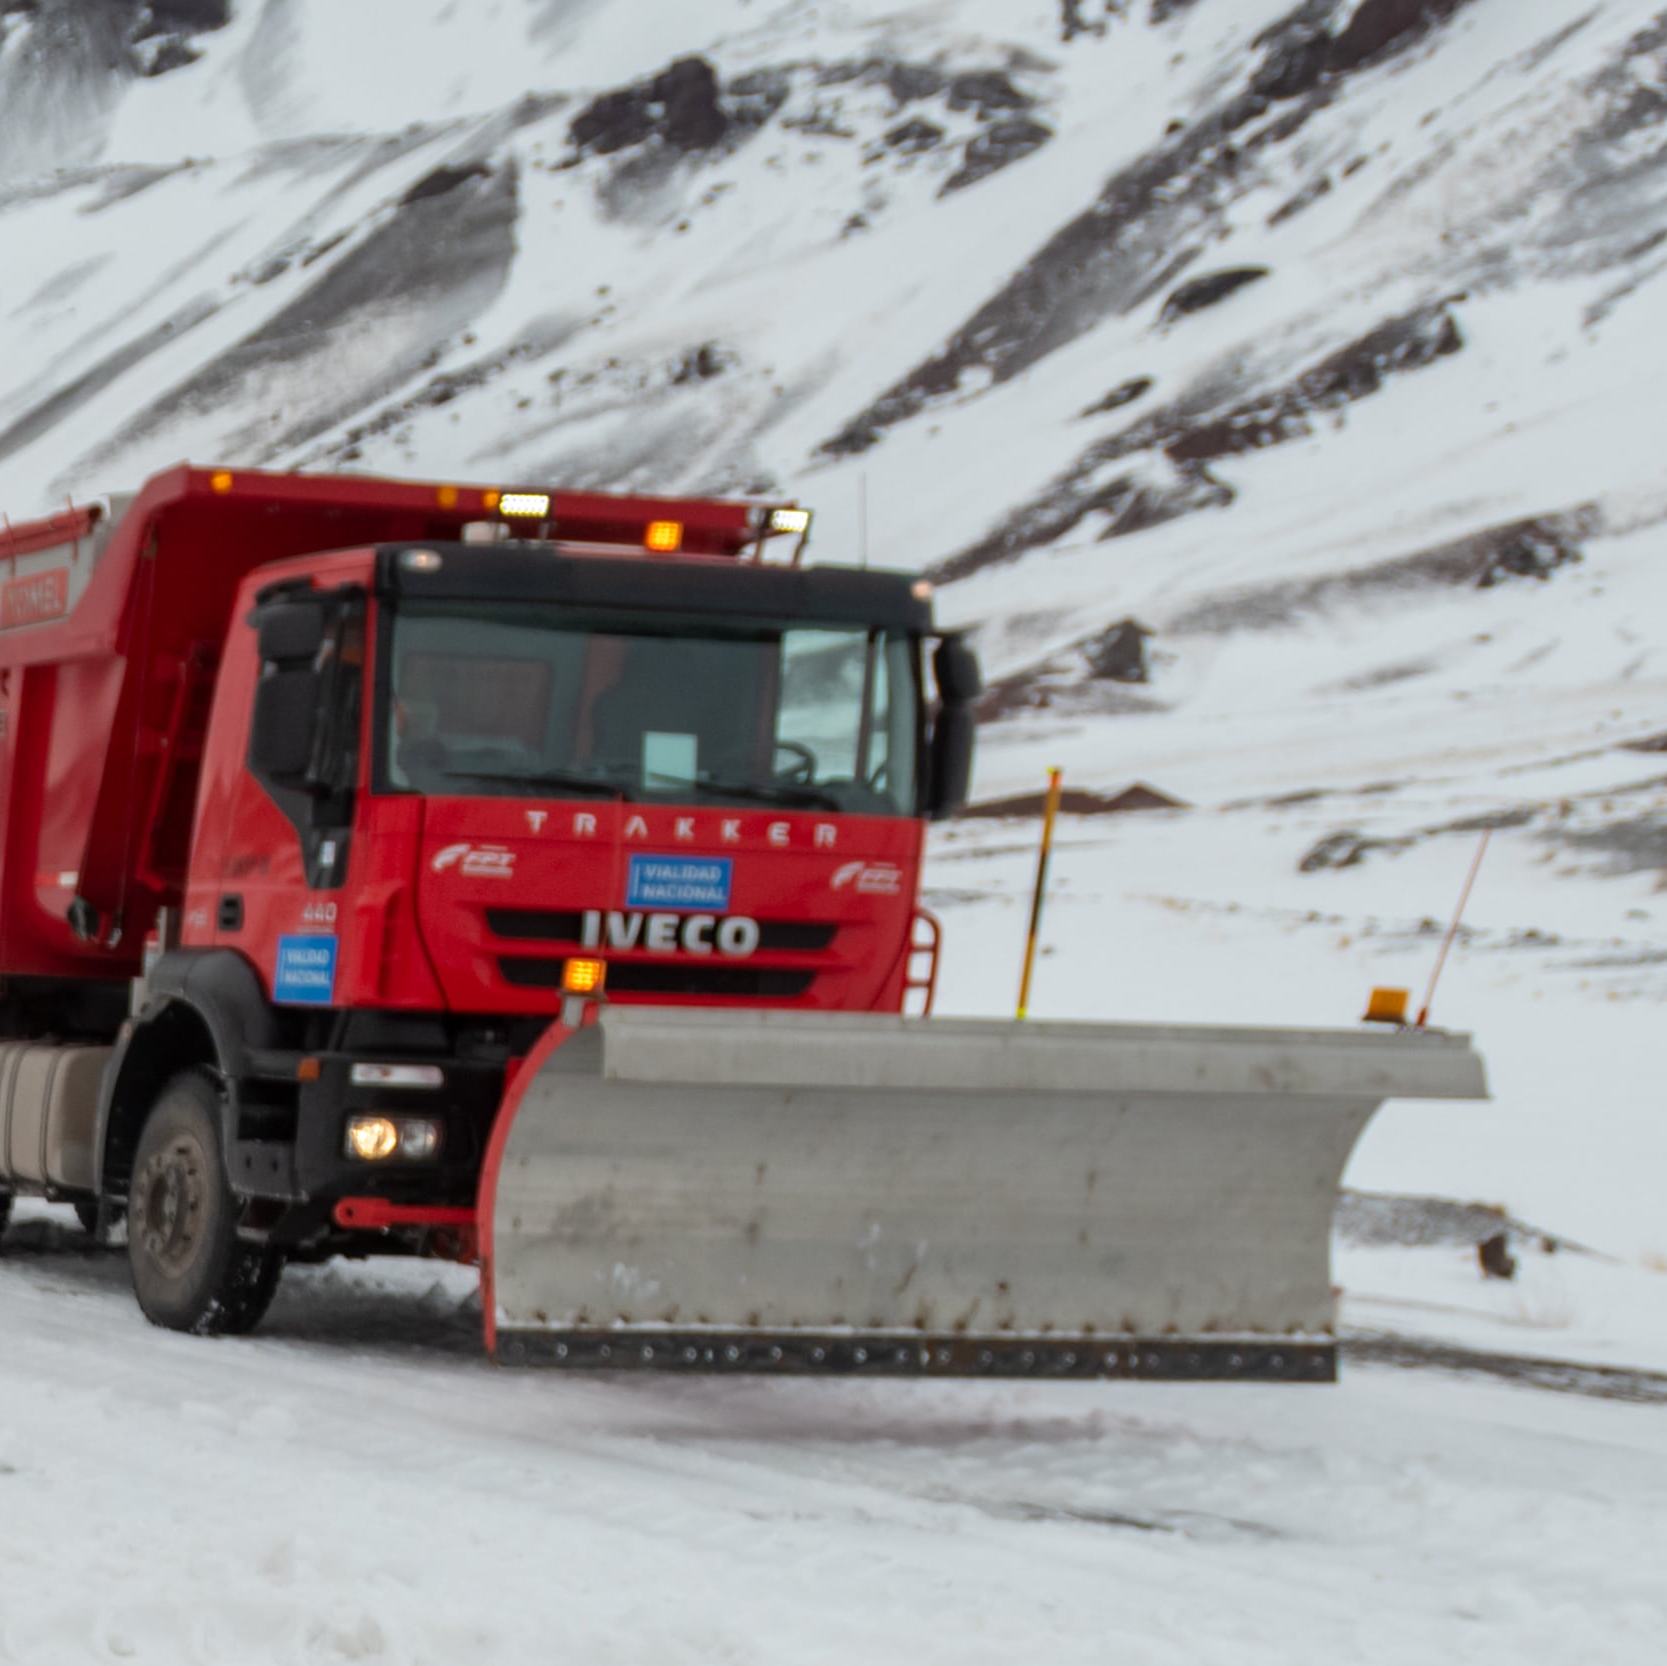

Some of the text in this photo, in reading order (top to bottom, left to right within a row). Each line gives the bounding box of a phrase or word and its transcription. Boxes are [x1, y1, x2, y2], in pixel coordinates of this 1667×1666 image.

[525, 810, 837, 847] TRAKKER
[643, 864, 722, 880] VIALIDAD
[641, 883, 728, 900] NACIONAL
[303, 902, 337, 921] 440
[581, 909, 761, 958] IVECO
